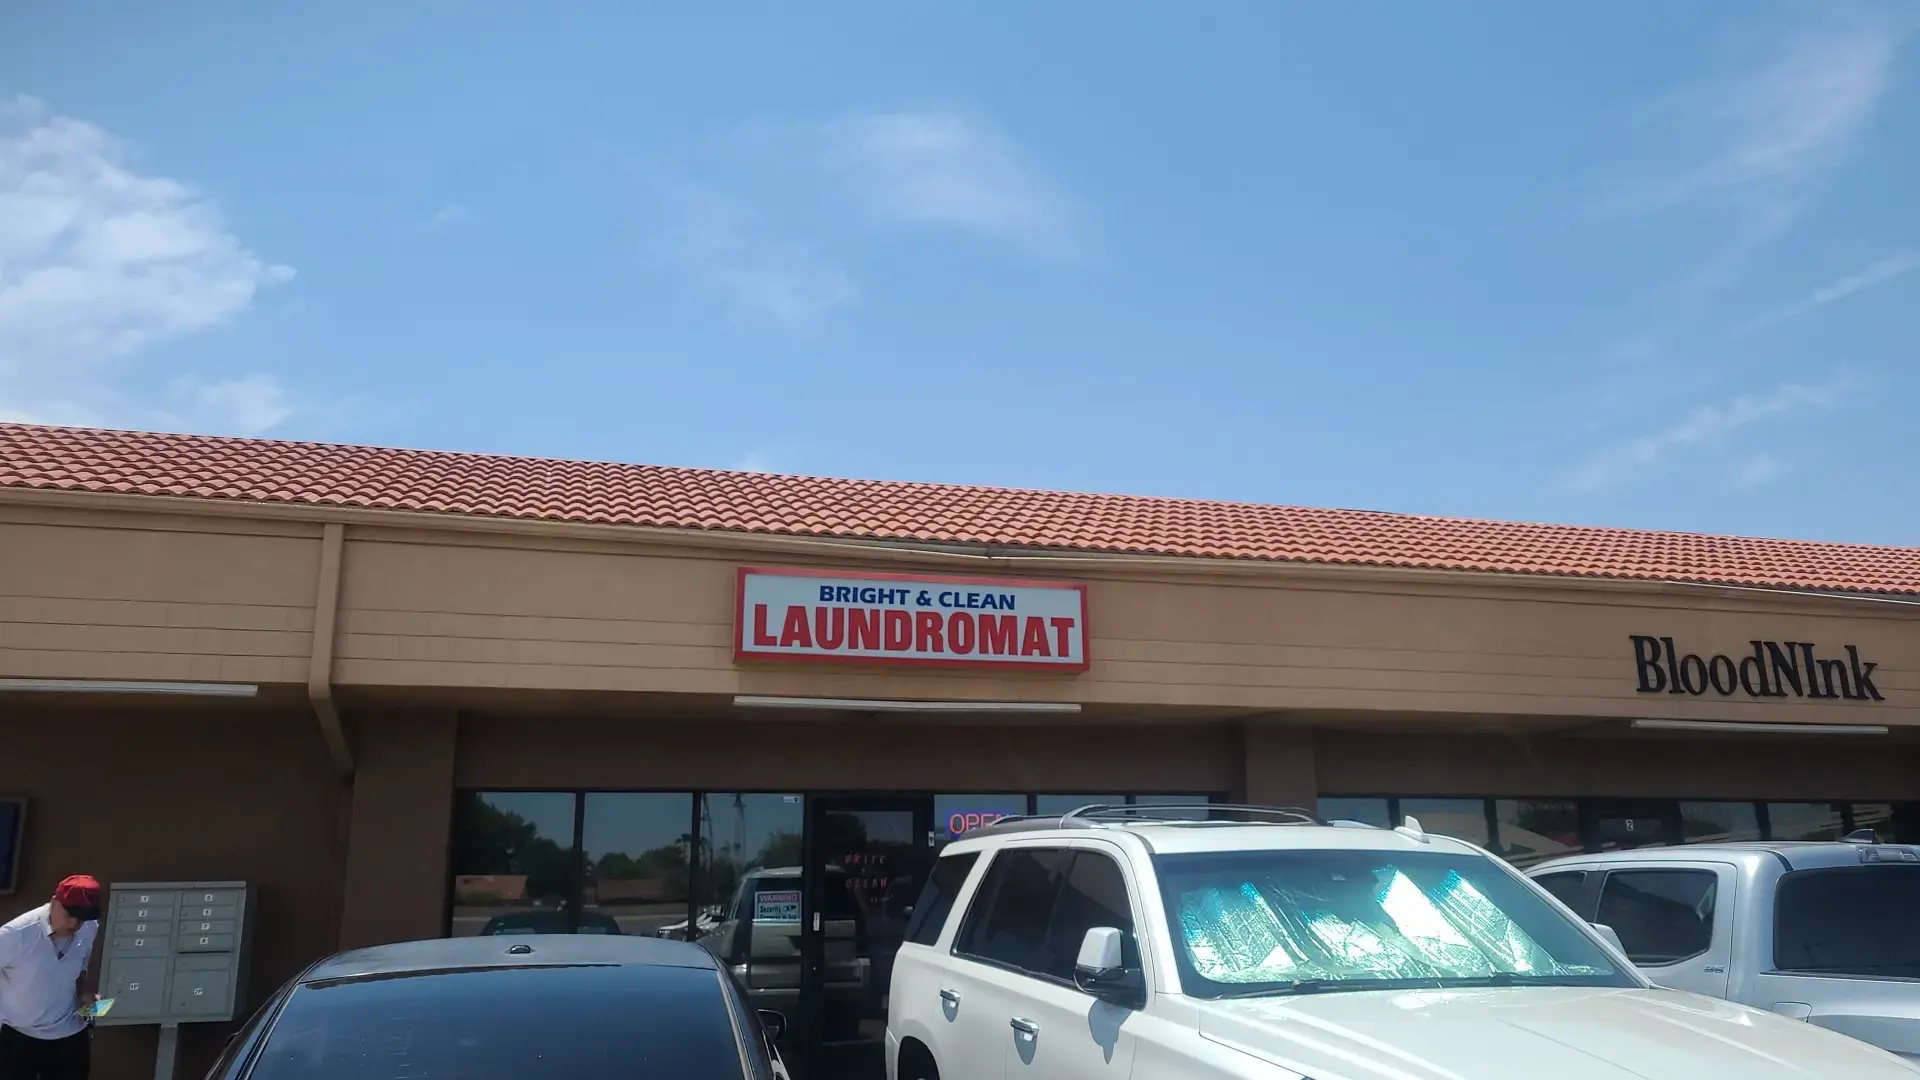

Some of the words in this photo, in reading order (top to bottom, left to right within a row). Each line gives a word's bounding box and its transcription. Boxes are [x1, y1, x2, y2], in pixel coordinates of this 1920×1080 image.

[819, 585, 910, 606] BRIGHT
[916, 591, 932, 607] &
[938, 591, 1016, 611] CLEAN
[753, 604, 1075, 658] LAUNDROMAT
[1629, 634, 1886, 701] BloodNInk
